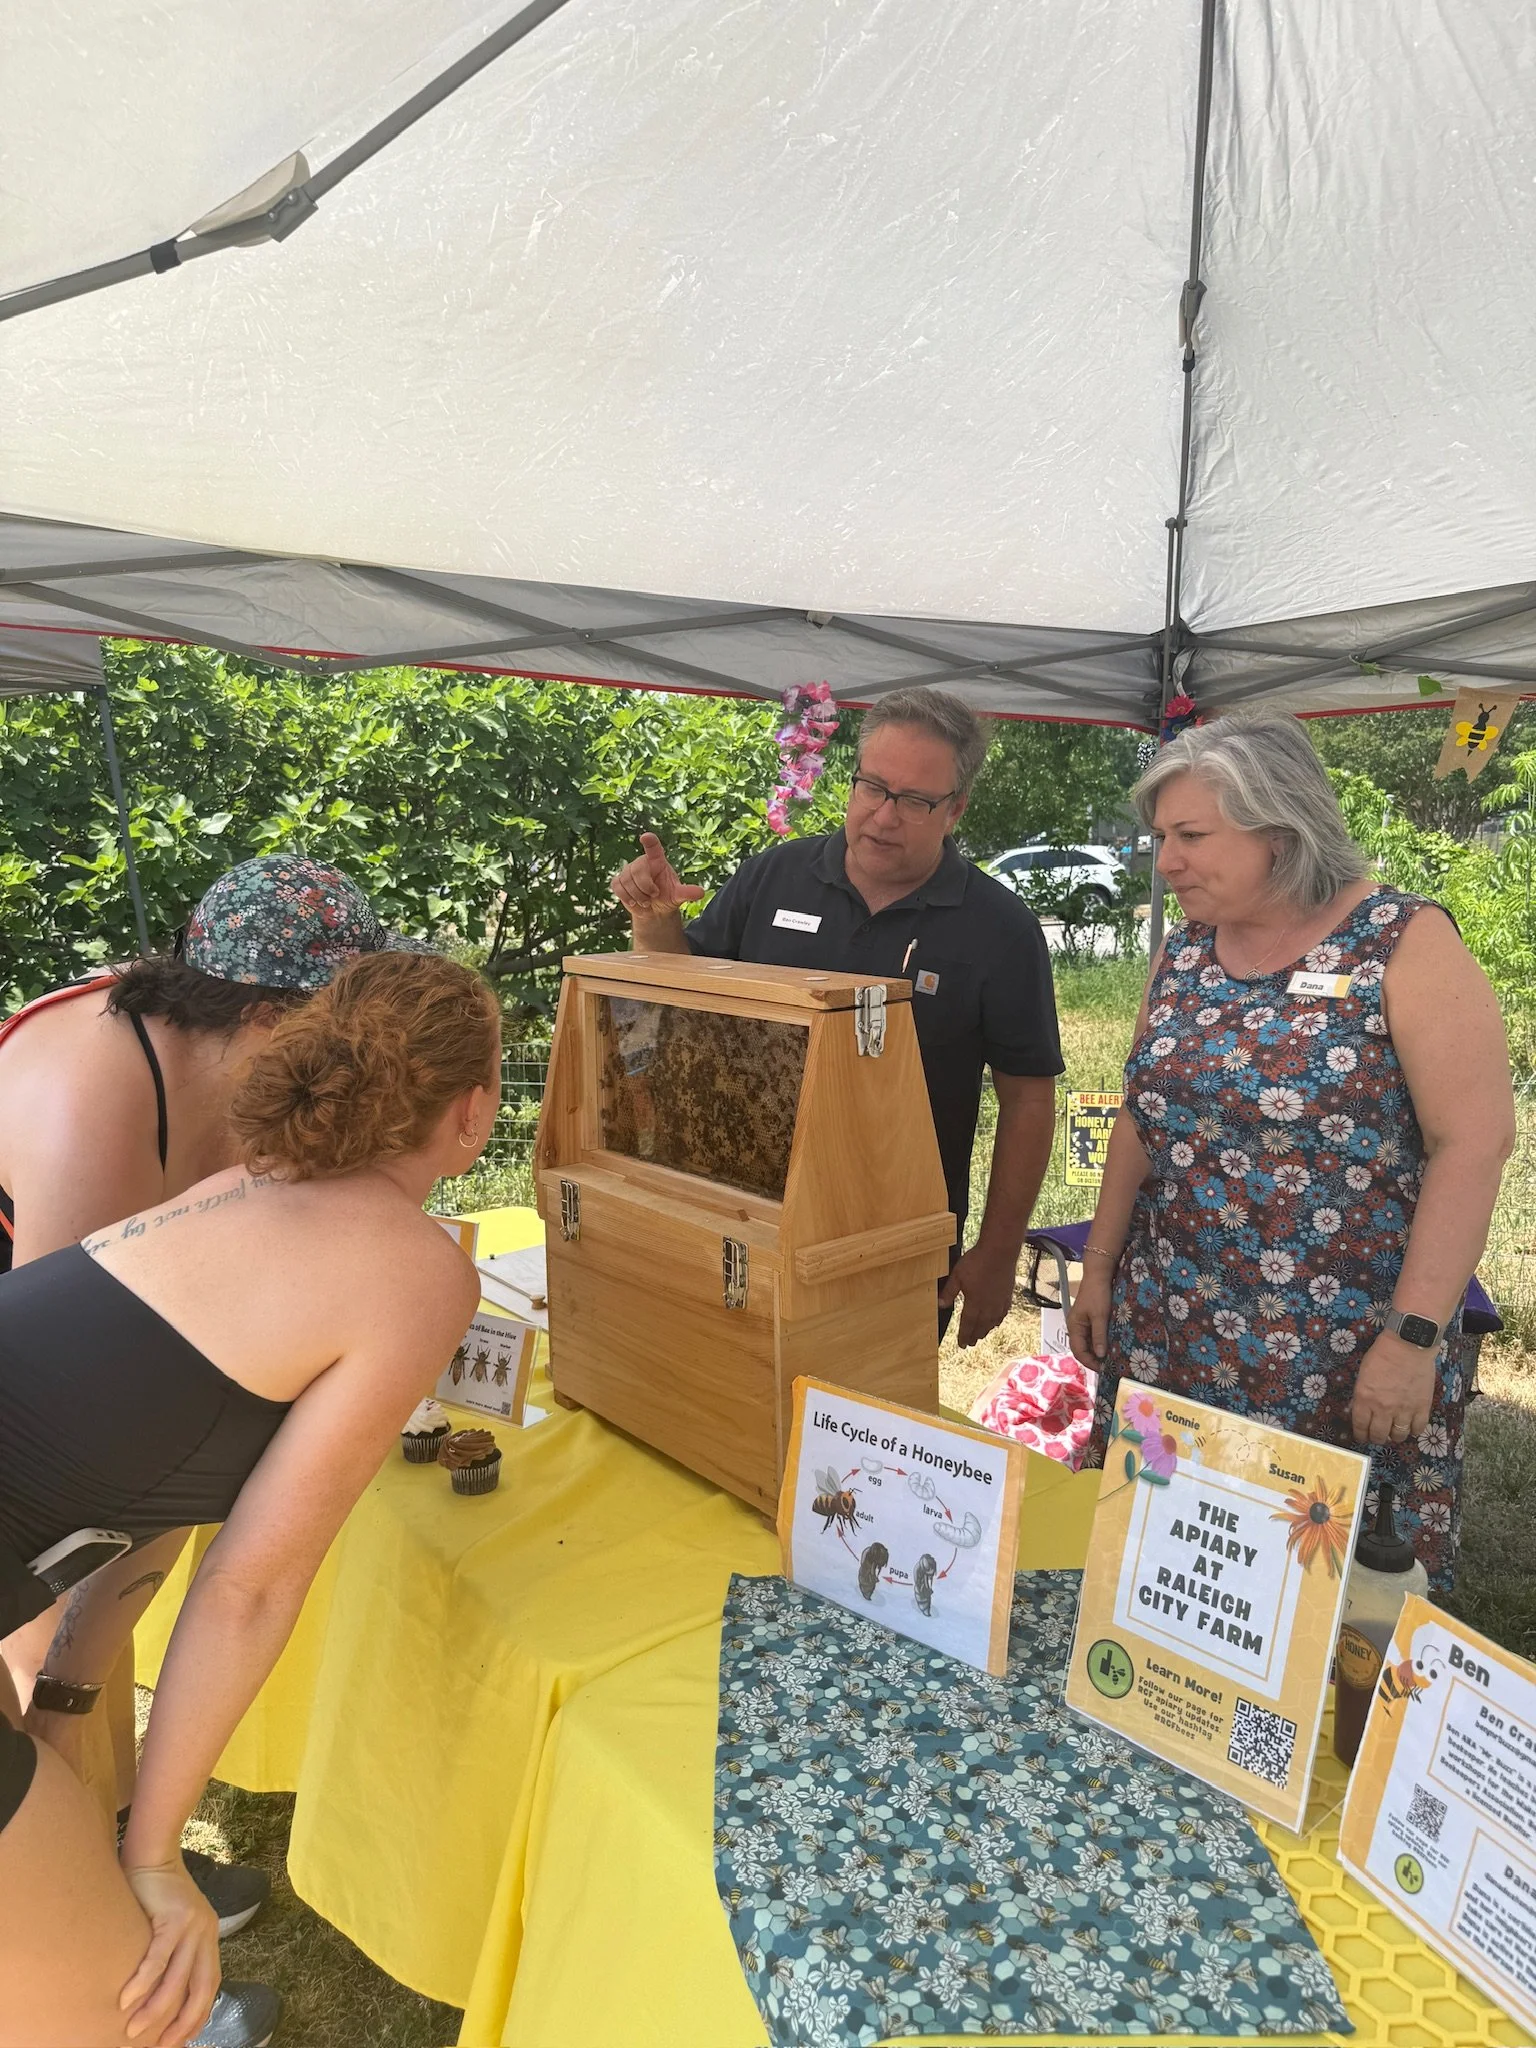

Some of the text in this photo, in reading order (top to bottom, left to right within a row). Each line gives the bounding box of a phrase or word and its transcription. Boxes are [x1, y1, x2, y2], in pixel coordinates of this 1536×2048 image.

[1300, 981, 1324, 991] Dana
[1080, 1094, 1096, 1104] BEE
[1074, 1116, 1106, 1128] HONEY
[1166, 1410, 1200, 1430] Connie
[814, 1411, 993, 1485] Life Cycle of a Honeybee
[868, 1474, 882, 1486] egg
[1268, 1463, 1306, 1485] Susan
[856, 1510, 874, 1523] adult
[923, 1504, 943, 1520] larva
[1198, 1500, 1240, 1534] THE
[1169, 1519, 1258, 1568] APIARY
[889, 1566, 909, 1580] pupa
[1192, 1554, 1224, 1581] AT
[1156, 1566, 1252, 1622] RALEIGH
[1138, 1585, 1264, 1656] CITY FARM
[1344, 1638, 1372, 1660] HONEY
[1448, 1643, 1492, 1688] Ben
[1146, 1658, 1223, 1704] Learn More!
[1138, 1676, 1224, 1724] Follow our page for
[1144, 1698, 1212, 1741] Use our hashtag
[1156, 1696, 1182, 1715] apiary
[1186, 1711, 1221, 1733] updates.
[1480, 1706, 1504, 1730] Ben
